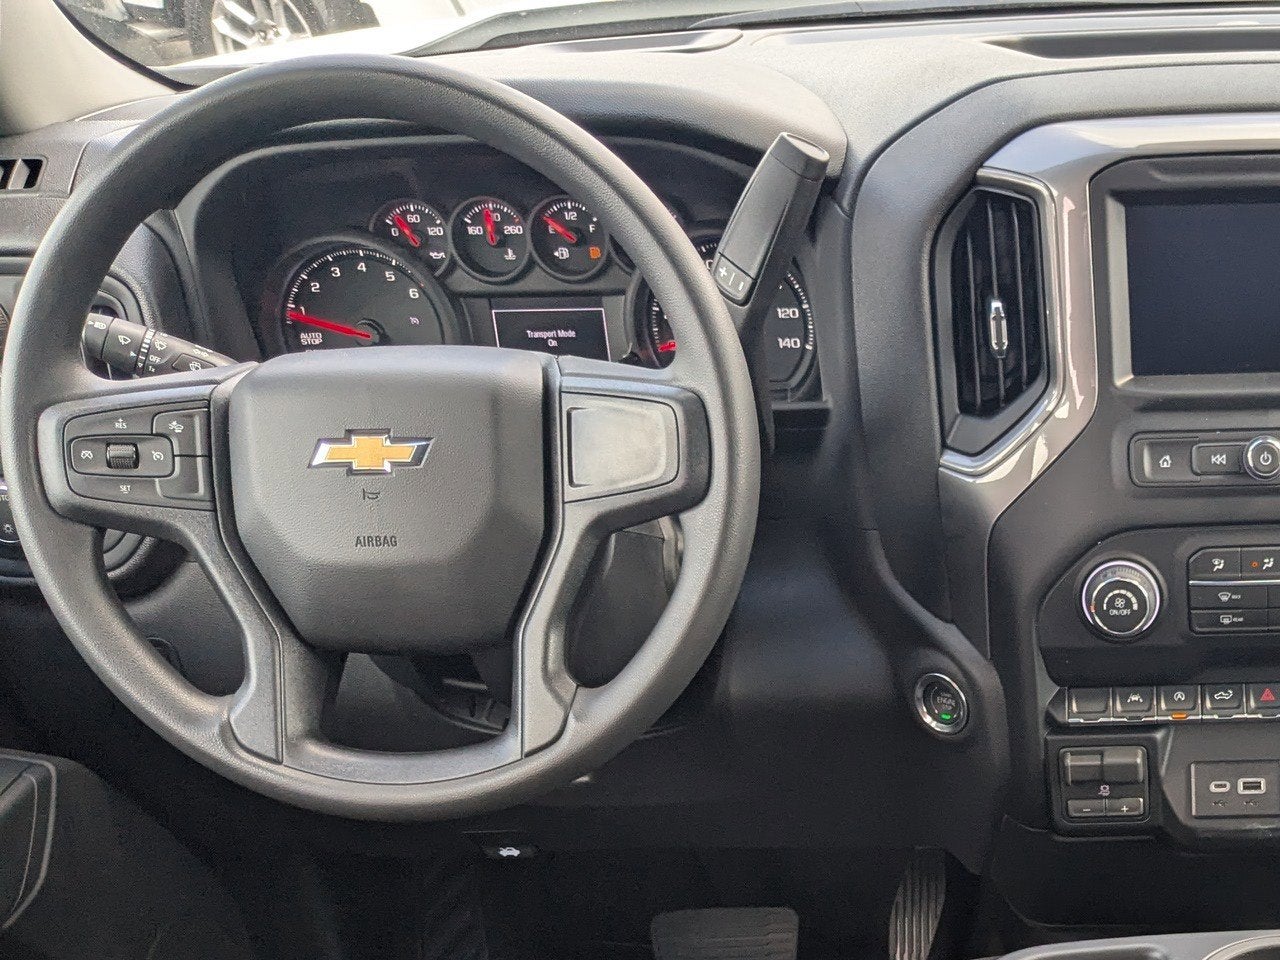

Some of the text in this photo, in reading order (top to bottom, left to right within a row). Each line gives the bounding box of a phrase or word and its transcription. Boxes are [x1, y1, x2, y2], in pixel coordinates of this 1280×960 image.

[407, 214, 420, 223] 60
[564, 211, 578, 220] 1/2
[391, 228, 399, 237] 0
[427, 227, 443, 236] 120
[467, 227, 483, 235] 160
[504, 226, 523, 235] 260
[331, 267, 340, 277] 3
[357, 262, 366, 272] 4
[385, 271, 395, 281] 5
[311, 282, 320, 293] 2
[409, 288, 419, 299] 6
[776, 307, 799, 319] 120
[526, 329, 576, 339] Transport Mode
[548, 339, 557, 347] On
[777, 337, 801, 349] 140
[149, 355, 161, 363] OFF
[355, 535, 398, 548] AIRBAG
